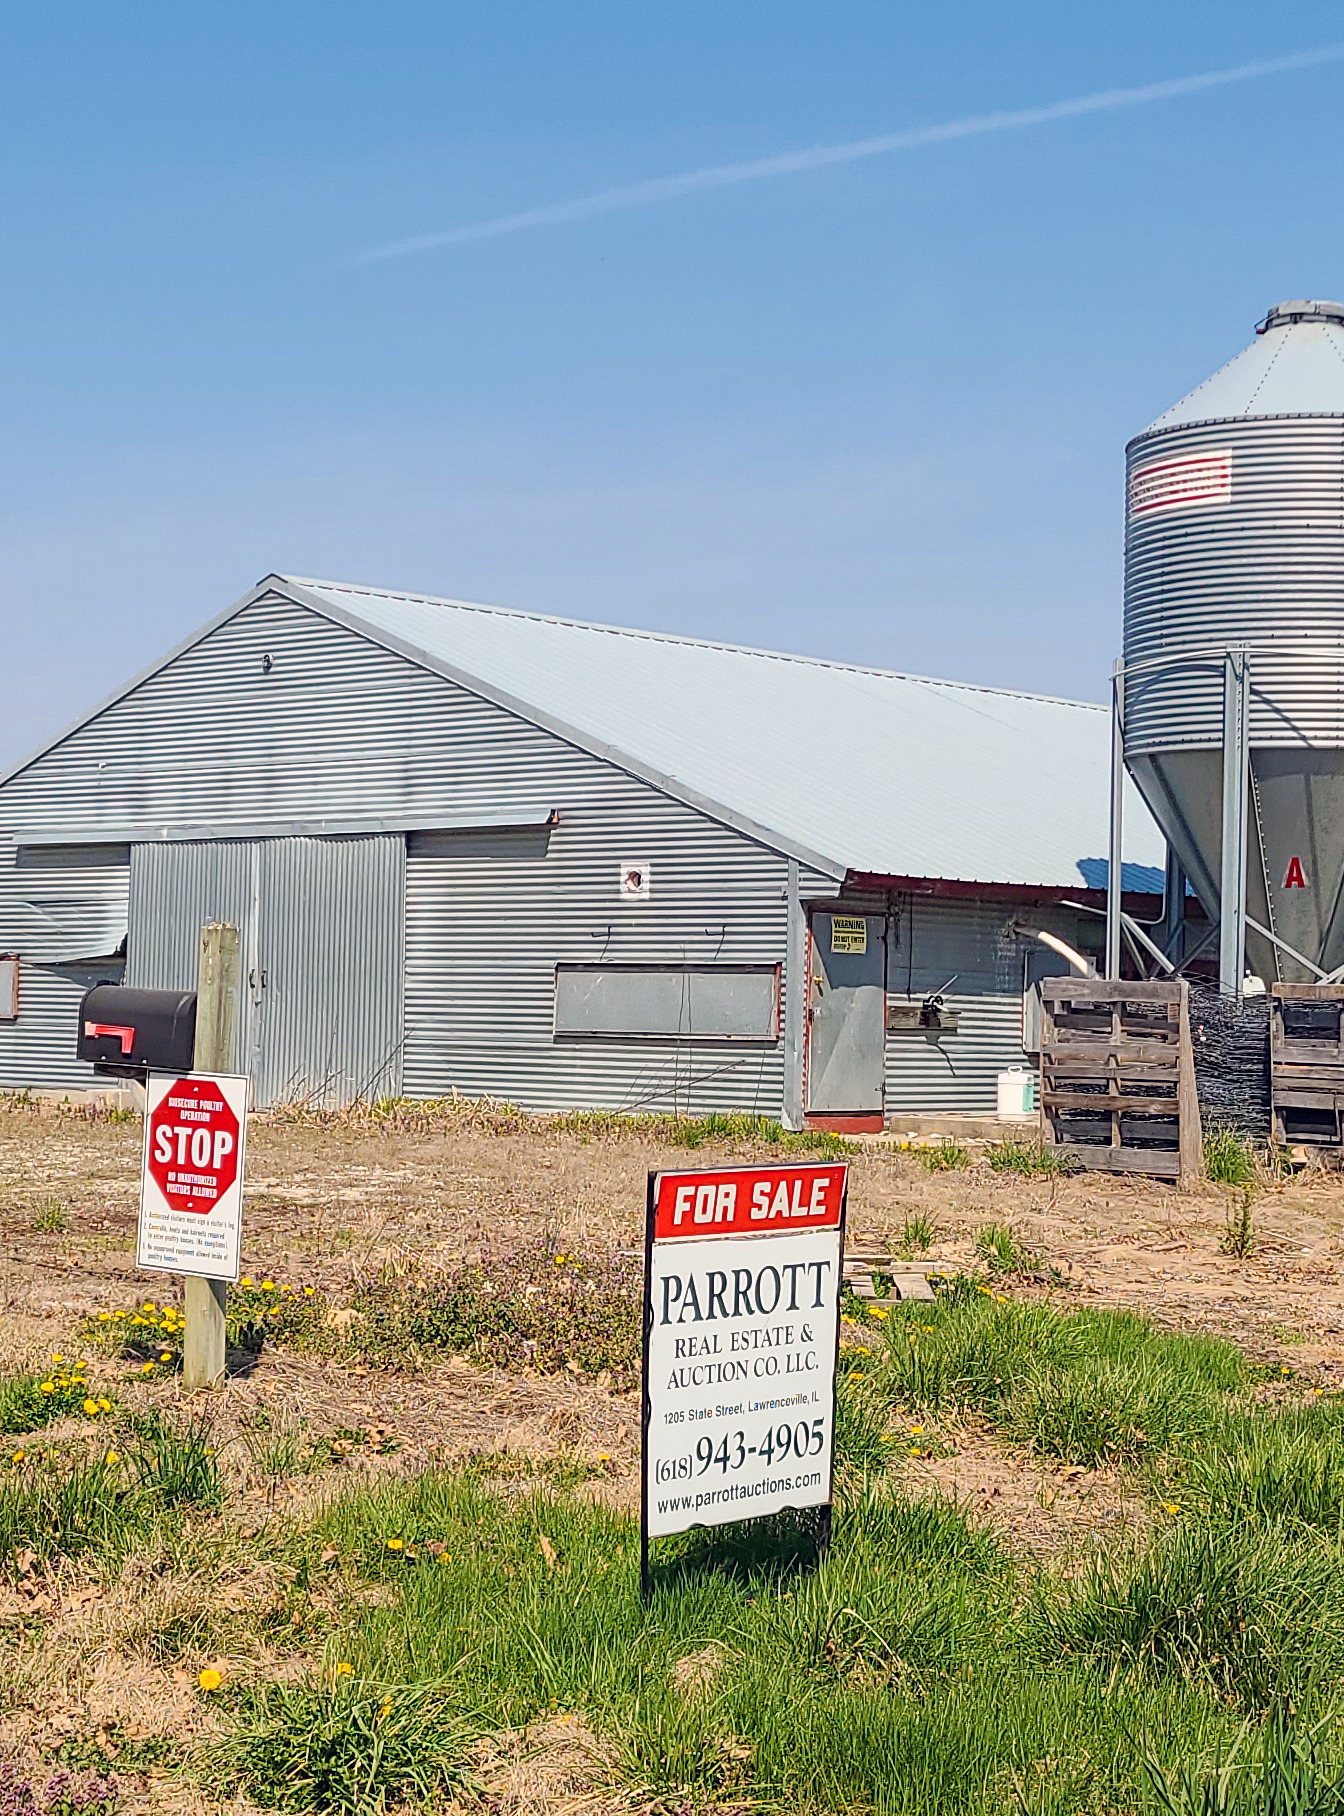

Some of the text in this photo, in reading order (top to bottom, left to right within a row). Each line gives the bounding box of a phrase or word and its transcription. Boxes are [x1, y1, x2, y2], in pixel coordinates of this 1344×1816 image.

[1283, 856, 1307, 889] A
[833, 918, 865, 930] WARNING
[180, 1109, 210, 1122] OPERATION
[199, 1099, 223, 1112] POULTRY
[154, 1124, 233, 1169] STOP
[673, 1177, 830, 1226] FOR SALE
[659, 1260, 831, 1326] PARROTT
[674, 1323, 814, 1359] REAL ESTATE &
[666, 1350, 819, 1390] AUCTION CO. LLC.
[663, 1390, 820, 1425] 1205 State Street, Lawrenceville, IL
[657, 1471, 821, 1514] www.parrottauctions.com
